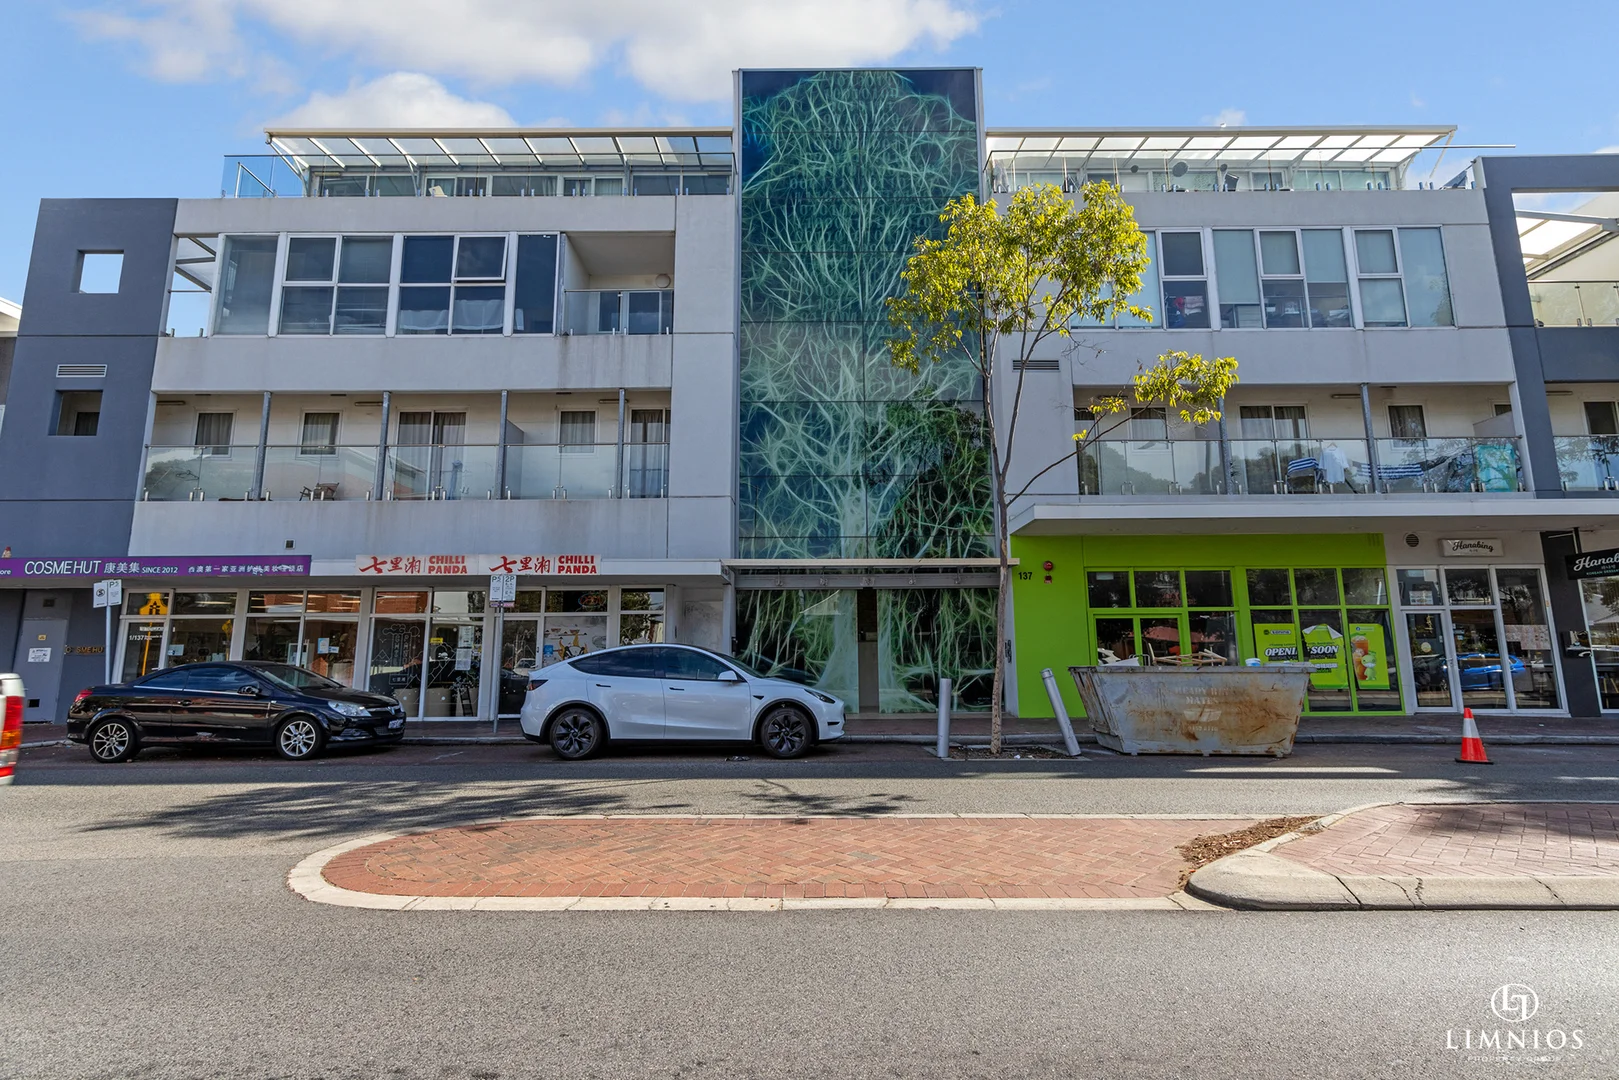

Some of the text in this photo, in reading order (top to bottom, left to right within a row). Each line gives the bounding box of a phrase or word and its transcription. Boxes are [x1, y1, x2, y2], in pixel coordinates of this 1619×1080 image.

[1452, 540, 1494, 553] Hanabing
[428, 555, 465, 564] CHILLI
[557, 555, 594, 564] CHILLI
[24, 560, 101, 575] COSMEHUT
[161, 566, 178, 574] 2012
[428, 565, 468, 574] PANDA
[557, 565, 597, 574] PANDA
[1018, 571, 1033, 580] 137
[1265, 645, 1339, 657] OPENI SOON
